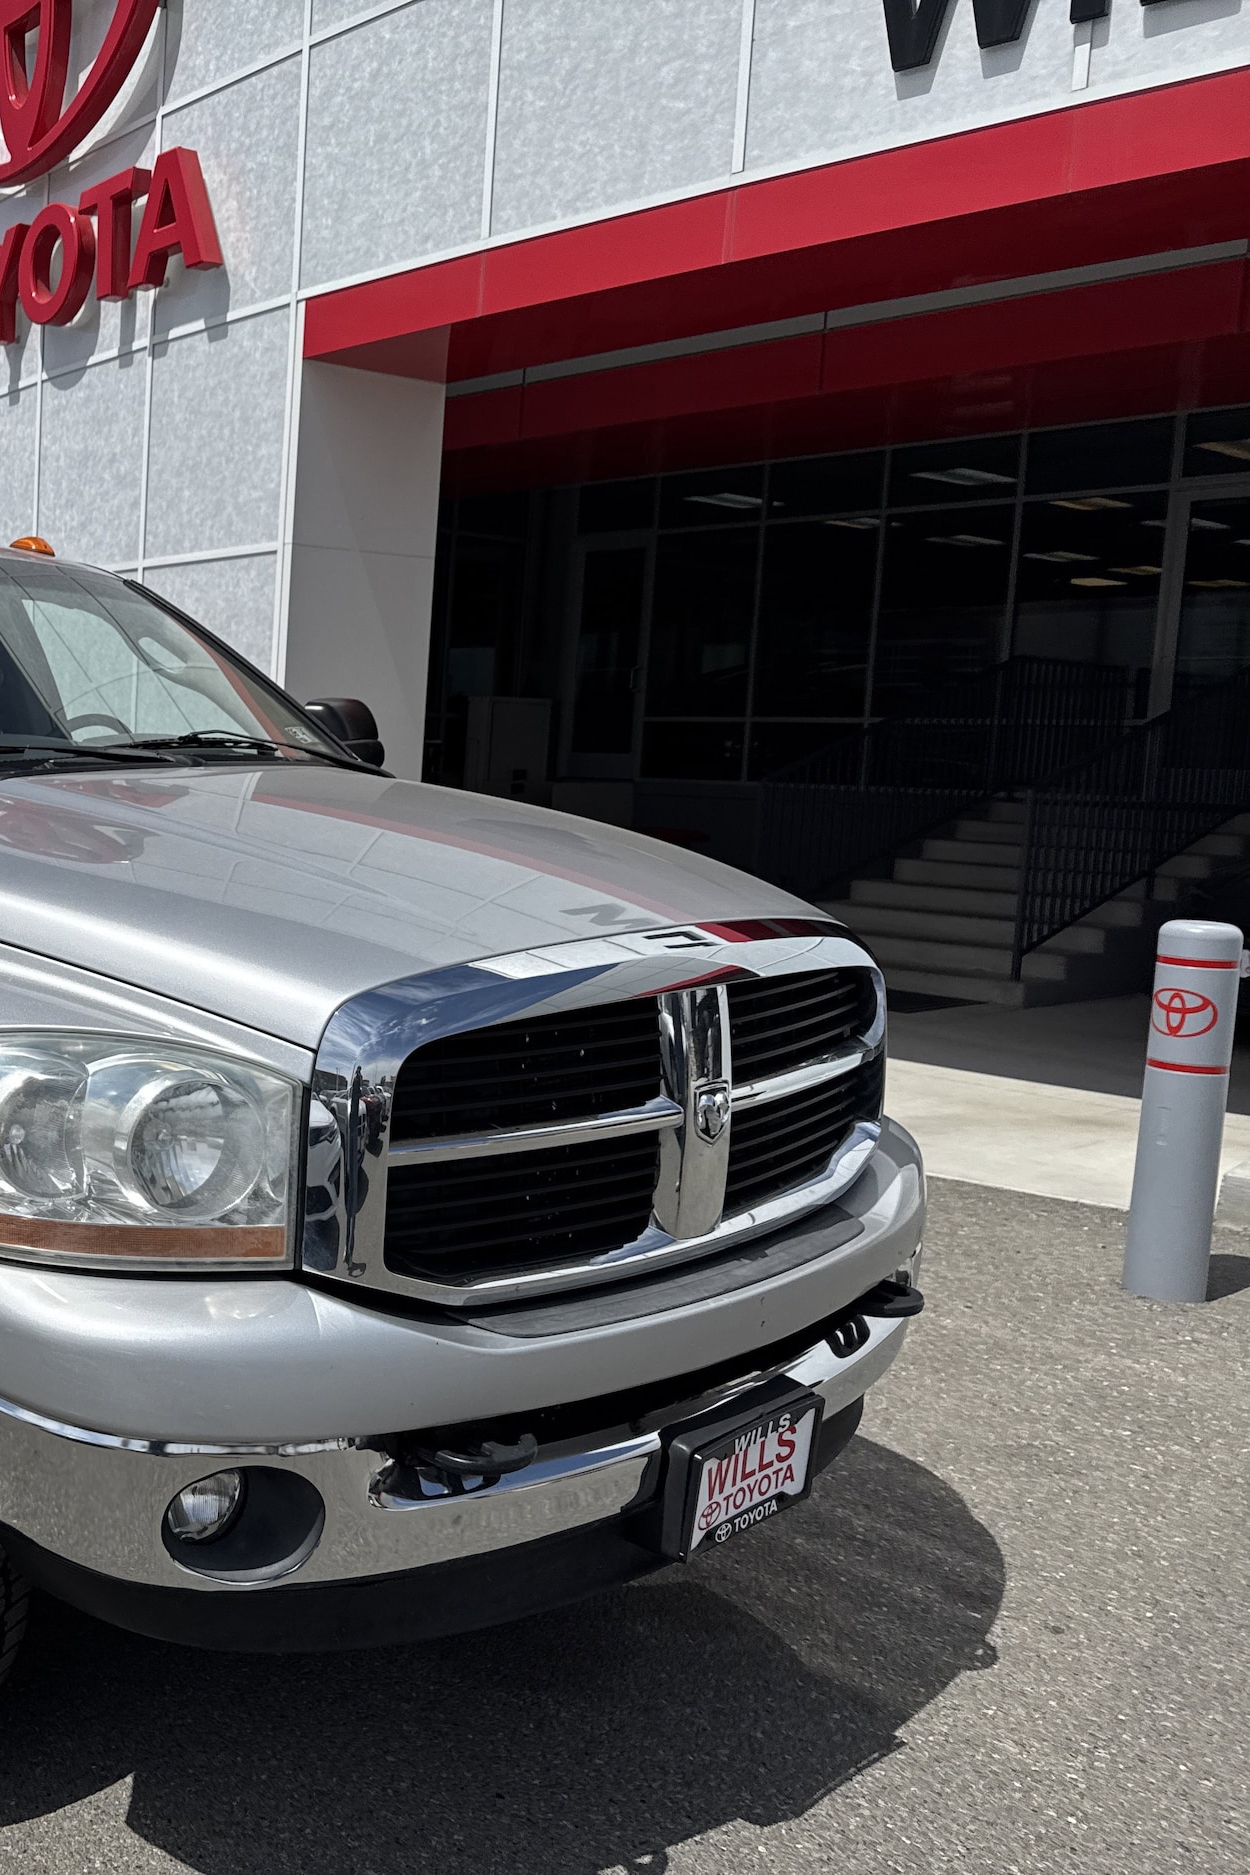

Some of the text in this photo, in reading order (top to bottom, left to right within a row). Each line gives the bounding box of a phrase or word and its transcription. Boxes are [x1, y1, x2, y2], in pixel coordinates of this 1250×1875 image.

[734, 1413, 791, 1454] WILLS
[707, 1425, 797, 1501] WILLS
[723, 1463, 795, 1516] TOYOTA
[734, 1499, 778, 1532] TOYOTA
